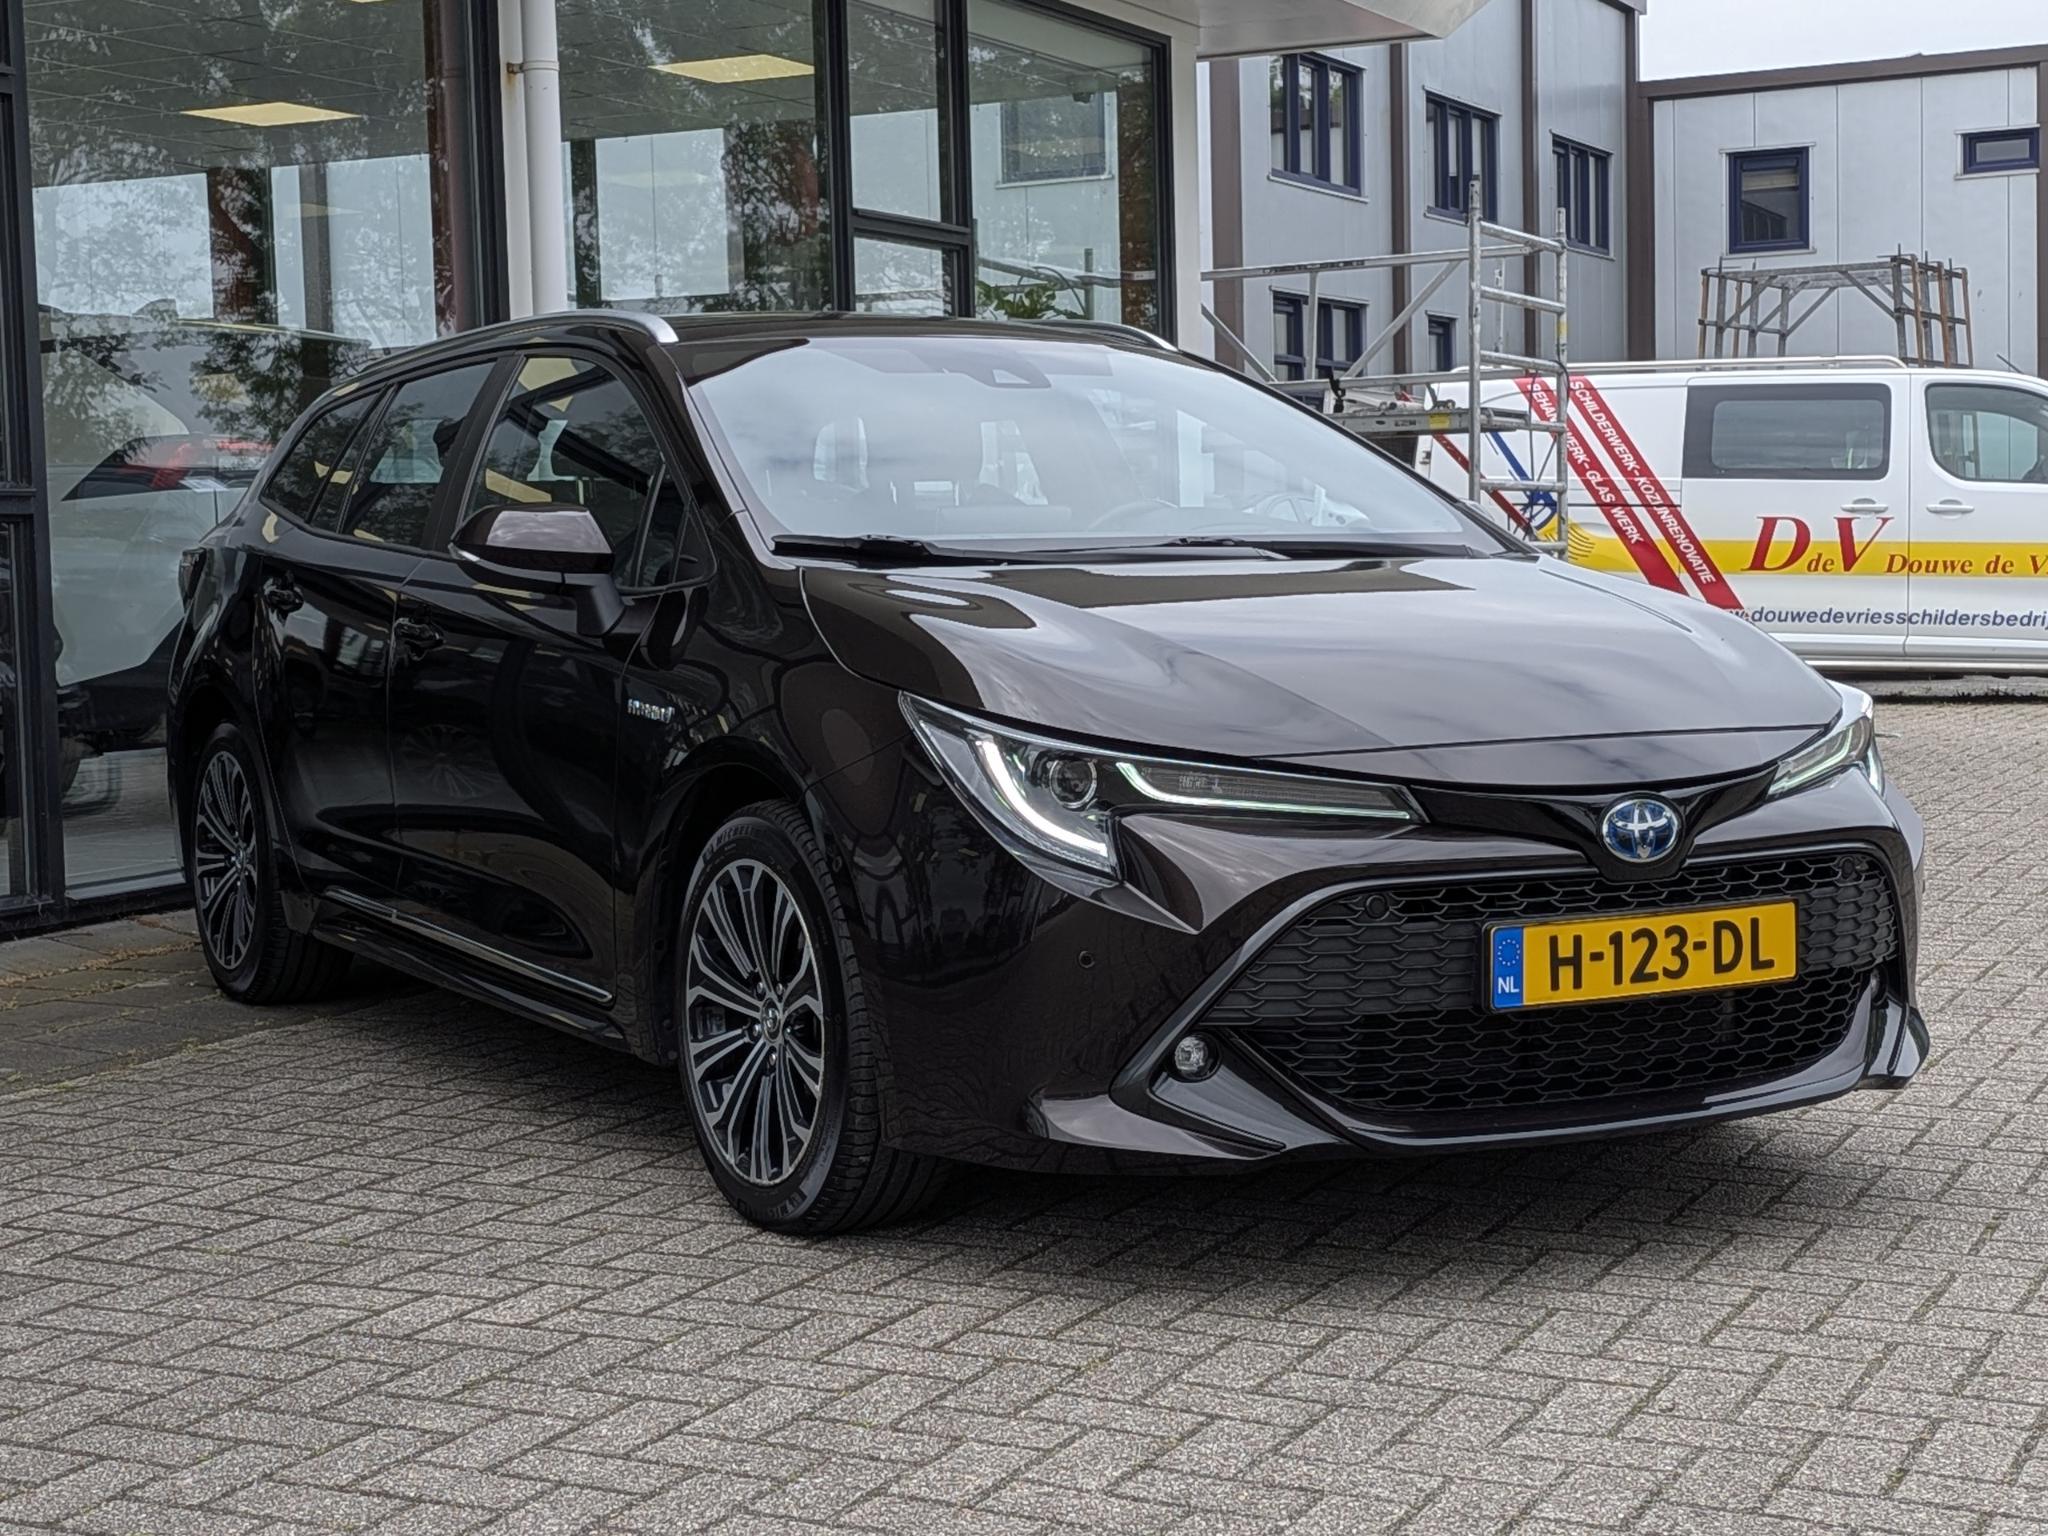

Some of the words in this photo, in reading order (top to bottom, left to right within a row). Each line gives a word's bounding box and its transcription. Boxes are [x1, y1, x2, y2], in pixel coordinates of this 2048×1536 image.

[1885, 554, 1973, 575] Douwe
[1985, 554, 2015, 575] de
[2029, 554, 2048, 575] V
[1549, 917, 1775, 992] H-123-DL
[1498, 976, 1520, 994] NL
